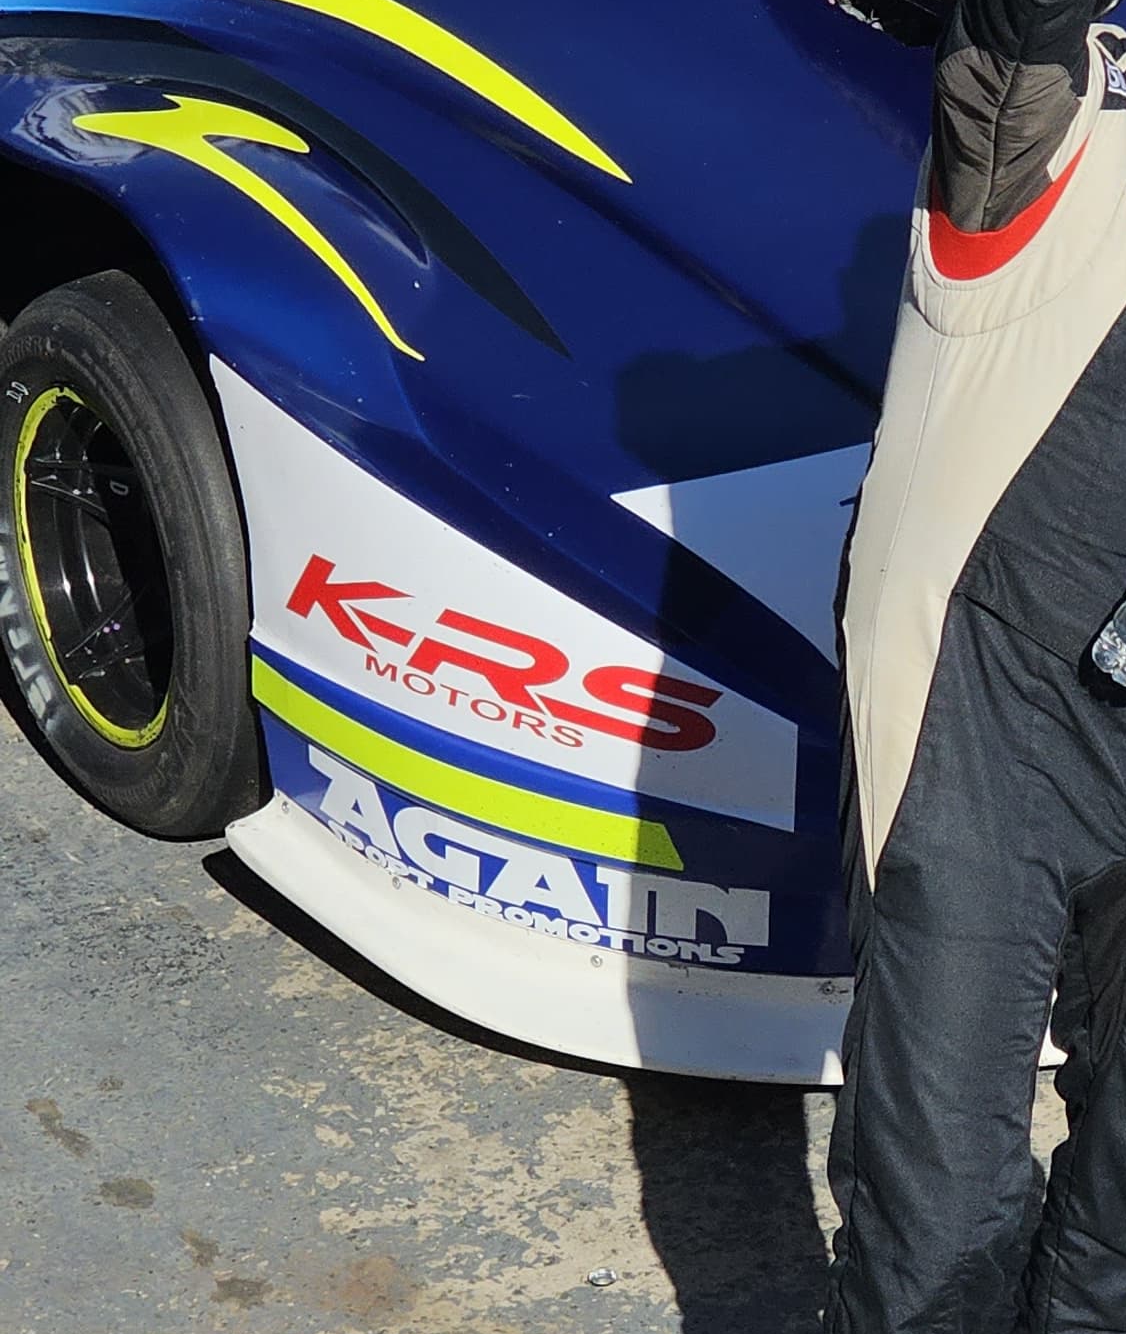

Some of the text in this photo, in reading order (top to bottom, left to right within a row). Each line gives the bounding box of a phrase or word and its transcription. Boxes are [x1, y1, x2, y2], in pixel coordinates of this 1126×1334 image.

[364, 653, 584, 750] MOTORS
[326, 819, 746, 966] SPORT PROMOTIONS
